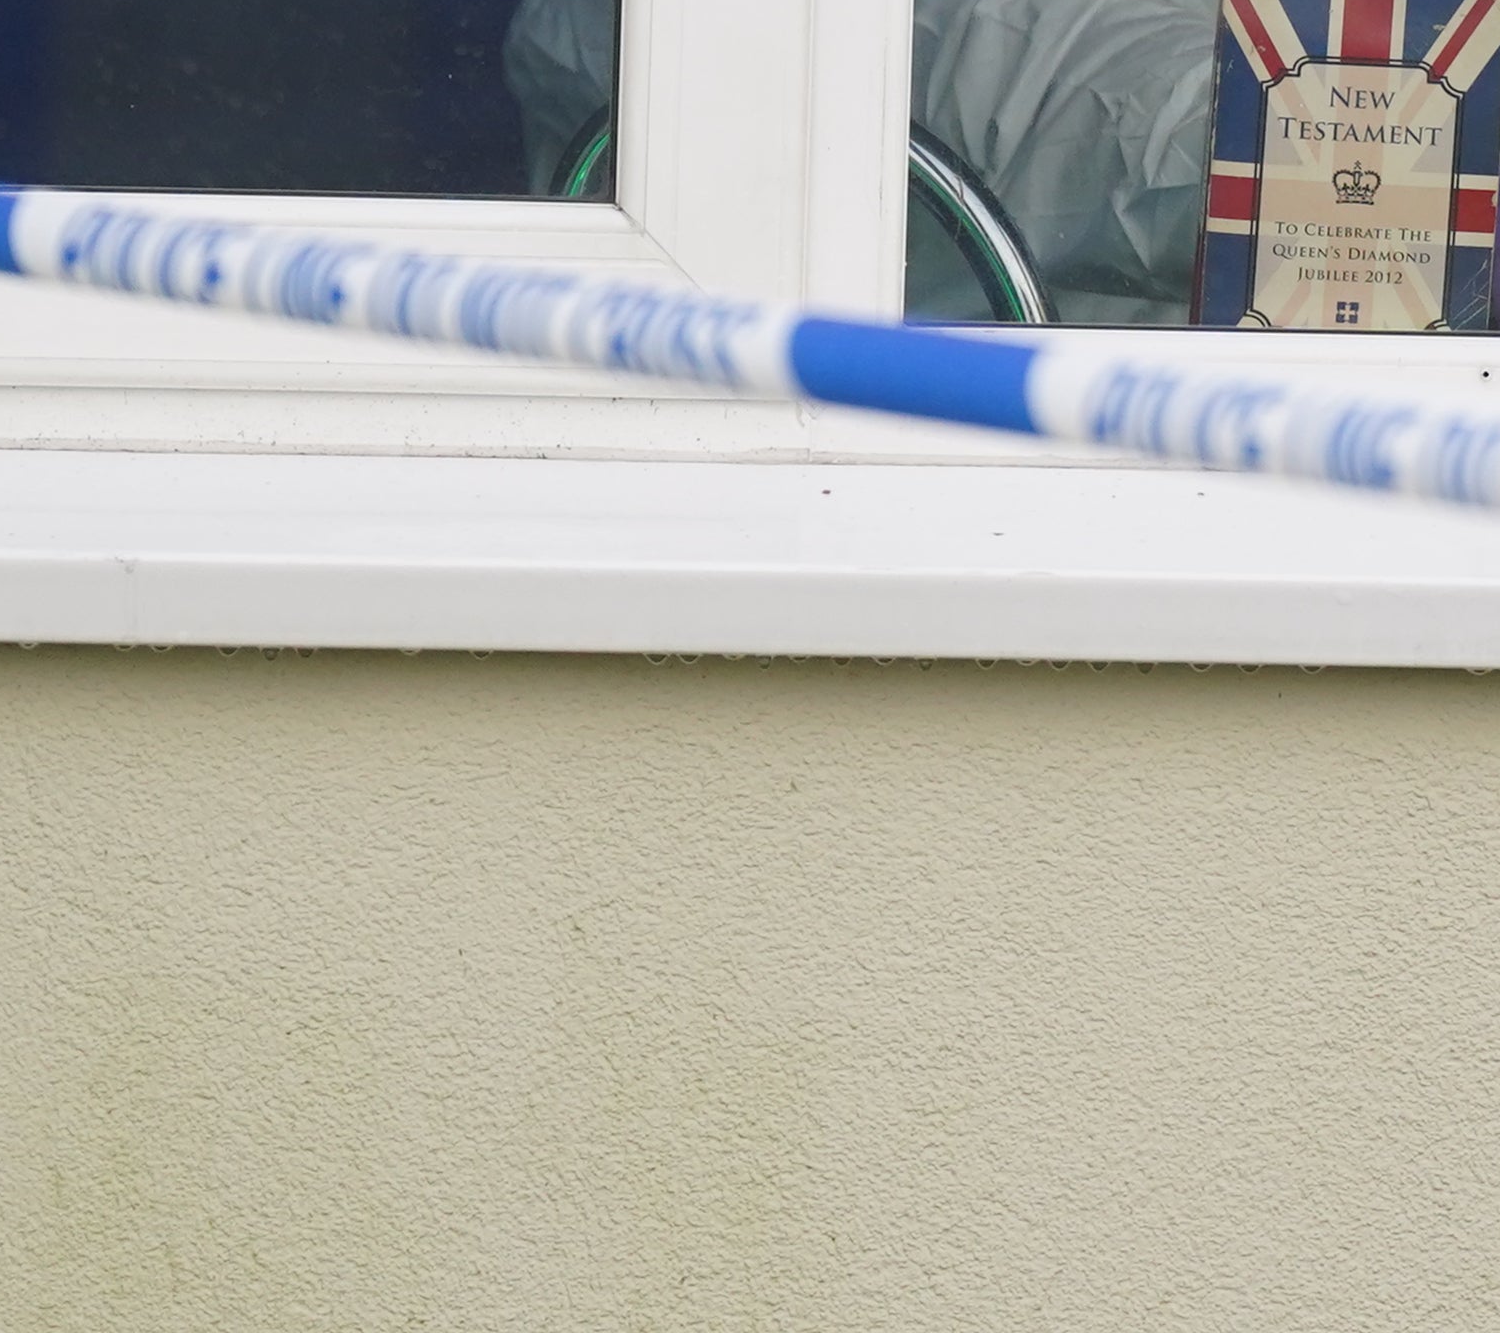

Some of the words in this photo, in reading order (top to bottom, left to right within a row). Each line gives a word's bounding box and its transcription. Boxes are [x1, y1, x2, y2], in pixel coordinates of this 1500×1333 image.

[1330, 86, 1396, 110] NEW
[1278, 117, 1443, 146] TESTAMENT
[1275, 221, 1298, 235] TO
[1304, 223, 1392, 240] CELEBRATE
[1398, 227, 1432, 242] THE
[1272, 244, 1341, 260] QUEEN'S
[1349, 247, 1431, 264] DIAMOND
[1297, 267, 1359, 283] JUBILEE
[1365, 270, 1403, 284] 2012
